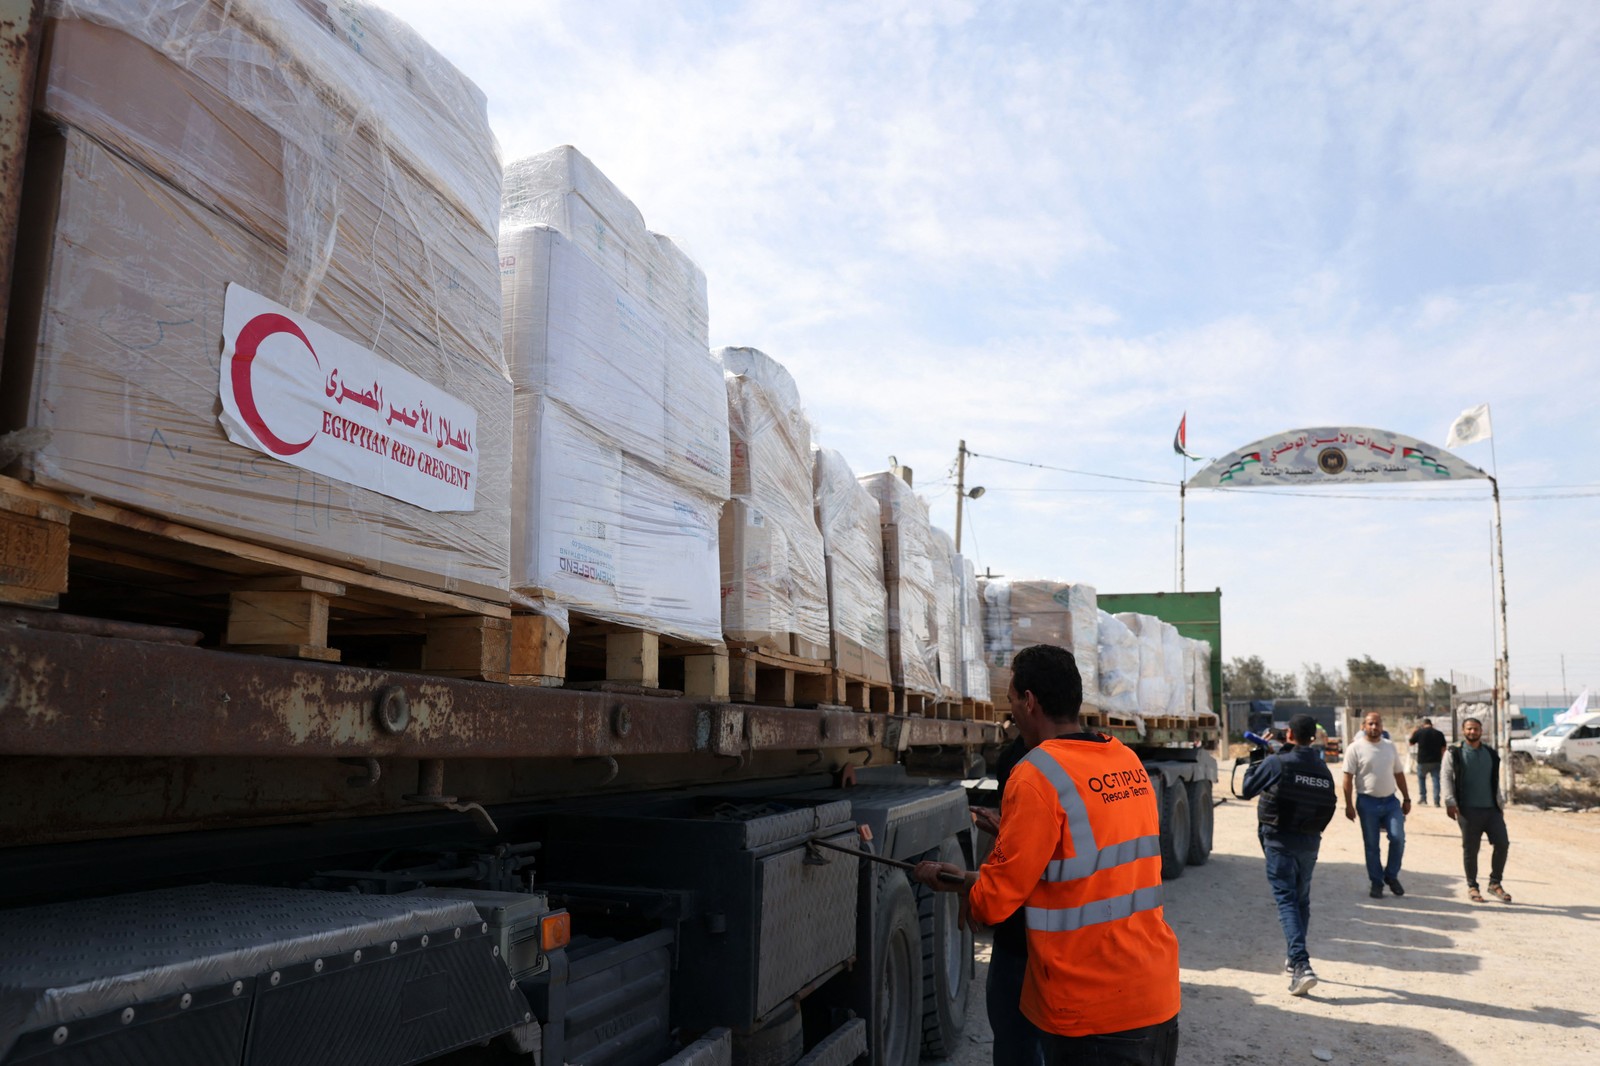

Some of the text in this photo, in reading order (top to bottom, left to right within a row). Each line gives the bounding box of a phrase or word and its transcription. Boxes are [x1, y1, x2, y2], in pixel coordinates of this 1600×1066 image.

[386, 400, 433, 436] الأحمر
[435, 416, 473, 454] الهلال
[1355, 435, 1396, 455] قوات
[322, 410, 471, 491] EGYPTIAN RED CRESCENT
[1088, 769, 1147, 792] OCTIPUS
[1295, 775, 1329, 788] PRESS
[1101, 786, 1149, 804] Rescue Team
